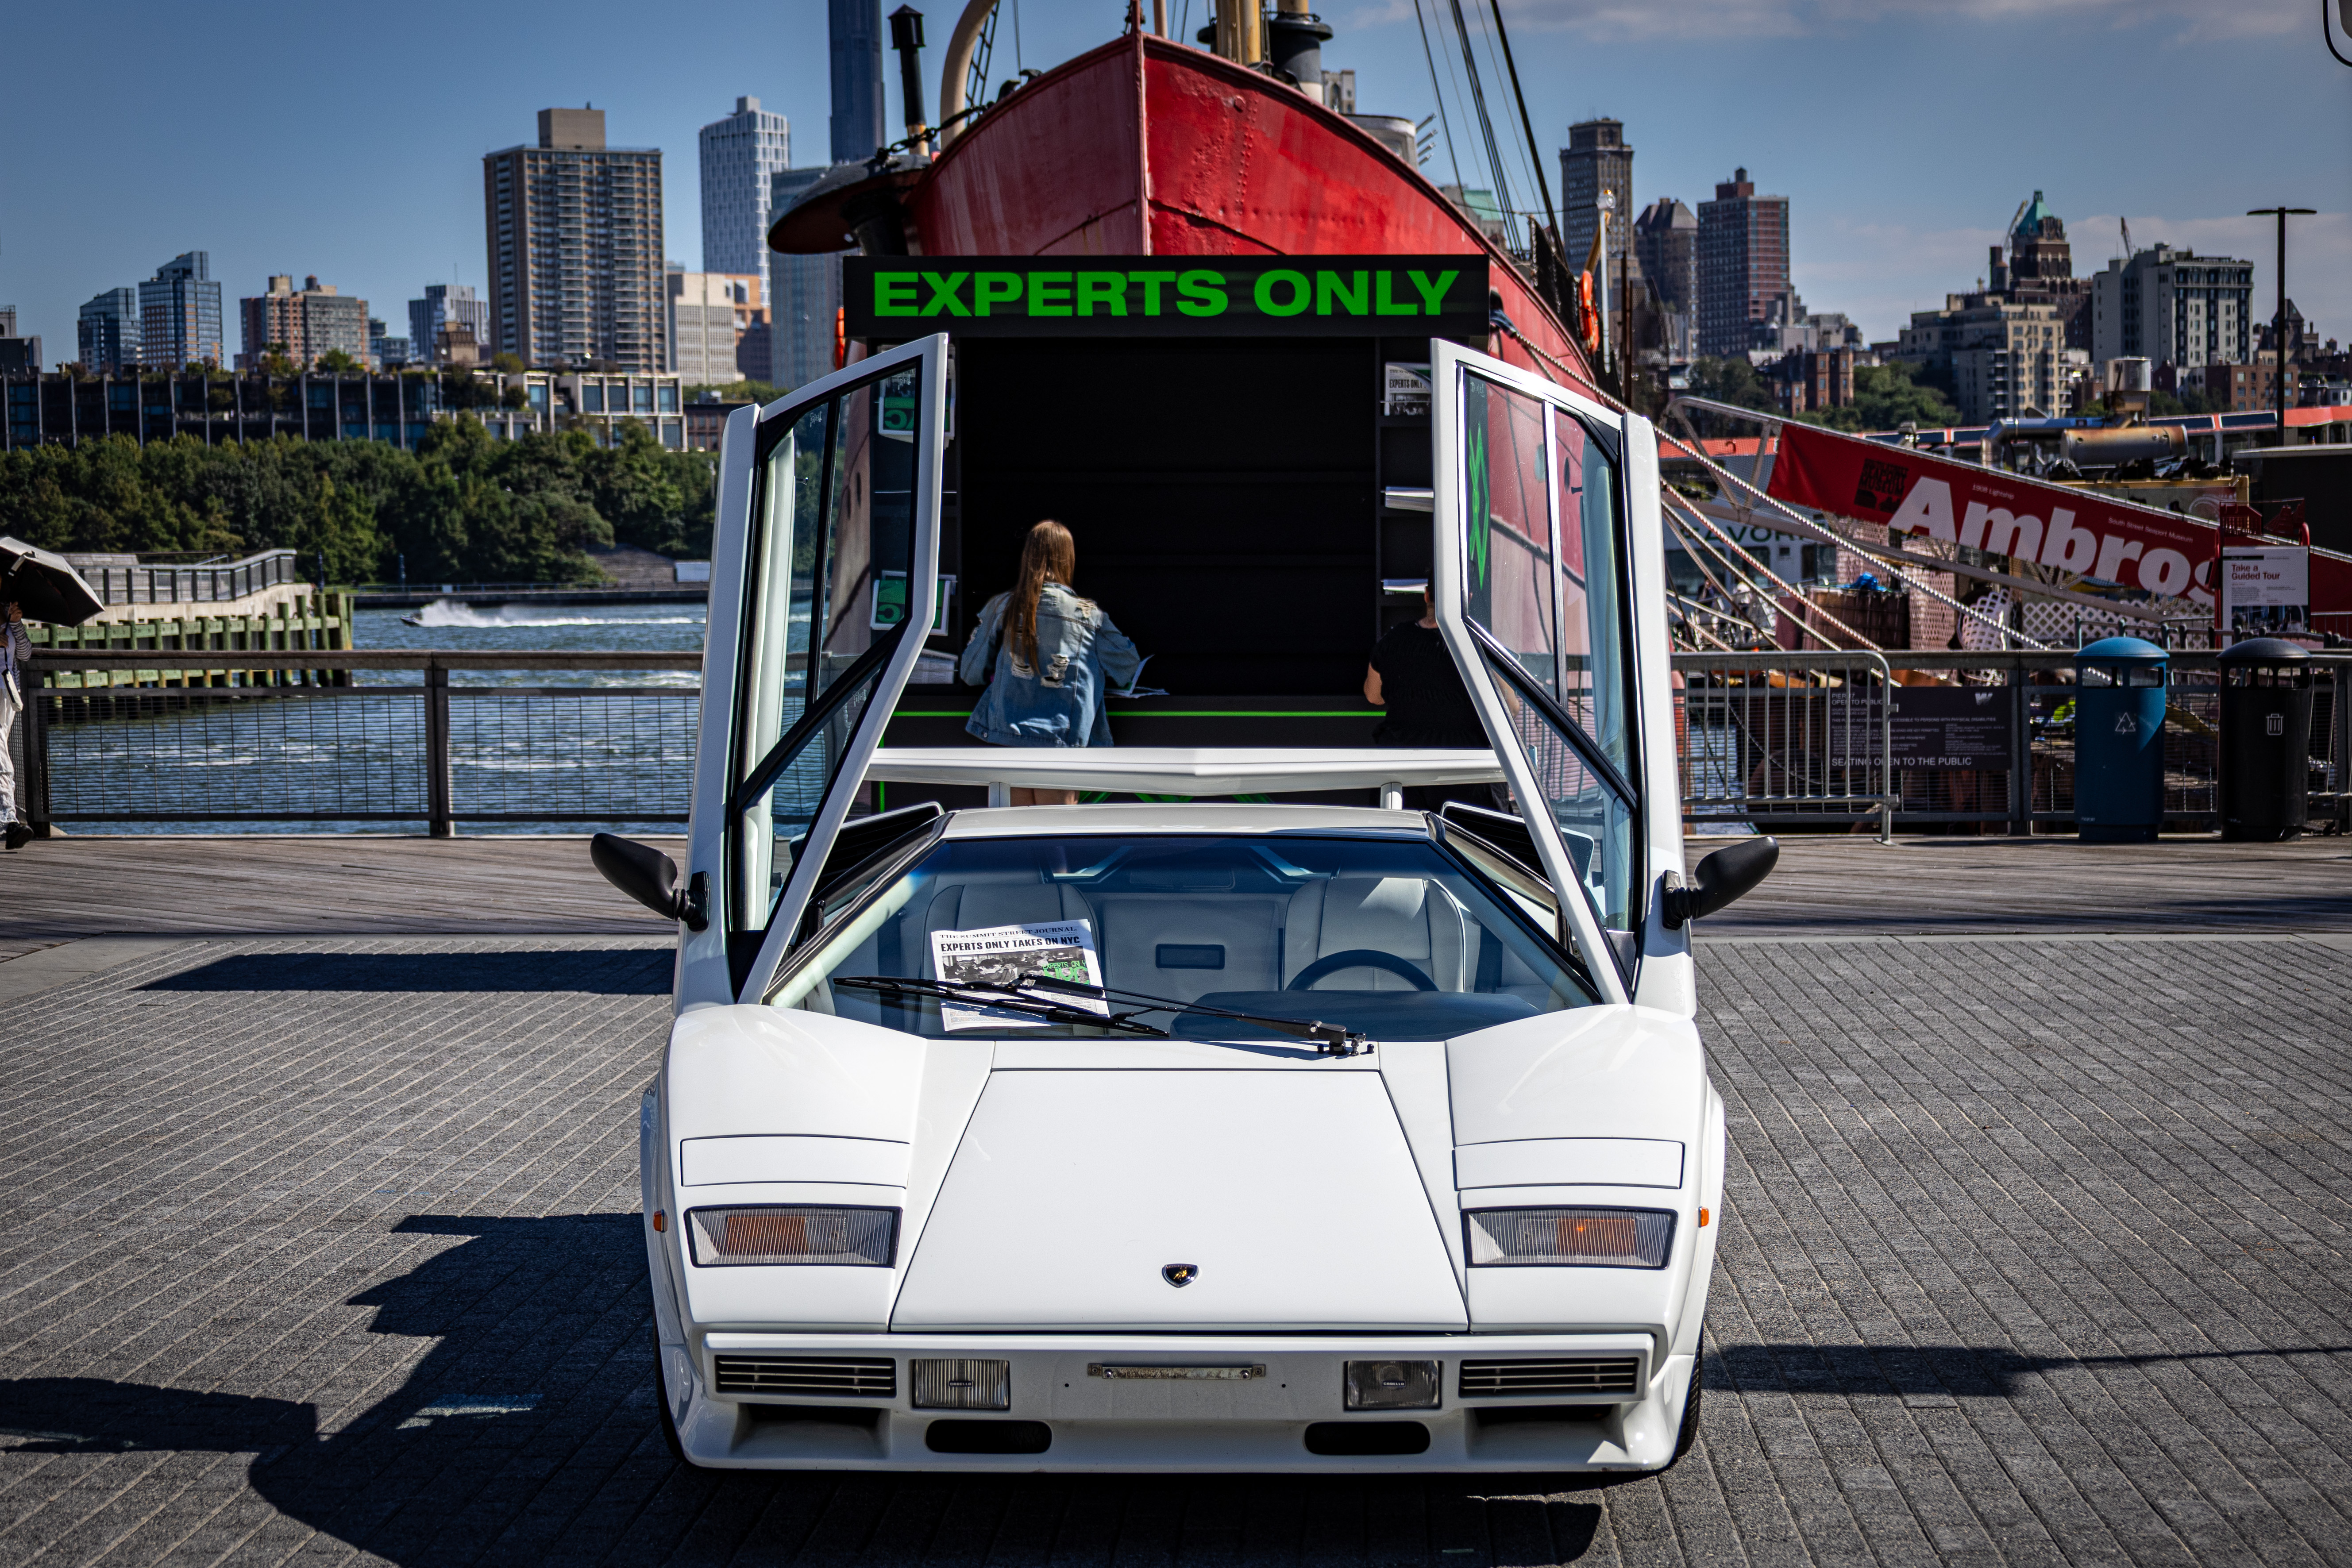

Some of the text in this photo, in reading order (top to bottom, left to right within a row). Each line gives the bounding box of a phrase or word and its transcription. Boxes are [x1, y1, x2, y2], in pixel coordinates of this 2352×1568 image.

[875, 270, 1459, 317] EXPERTS ONLY
[1389, 379, 1410, 388] EXPERTS
[1972, 483, 2014, 500] 1908 Lightship
[2108, 516, 2193, 543] South Street Seaport Museum
[1889, 476, 2215, 607] Ambros
[2232, 564, 2250, 572] Take
[2263, 572, 2280, 580] Tour
[1831, 757, 1972, 767] SETING OEN TO THE PUBLIC
[941, 942, 983, 952] EXPERTS
[1012, 938, 1042, 947] TAKES
